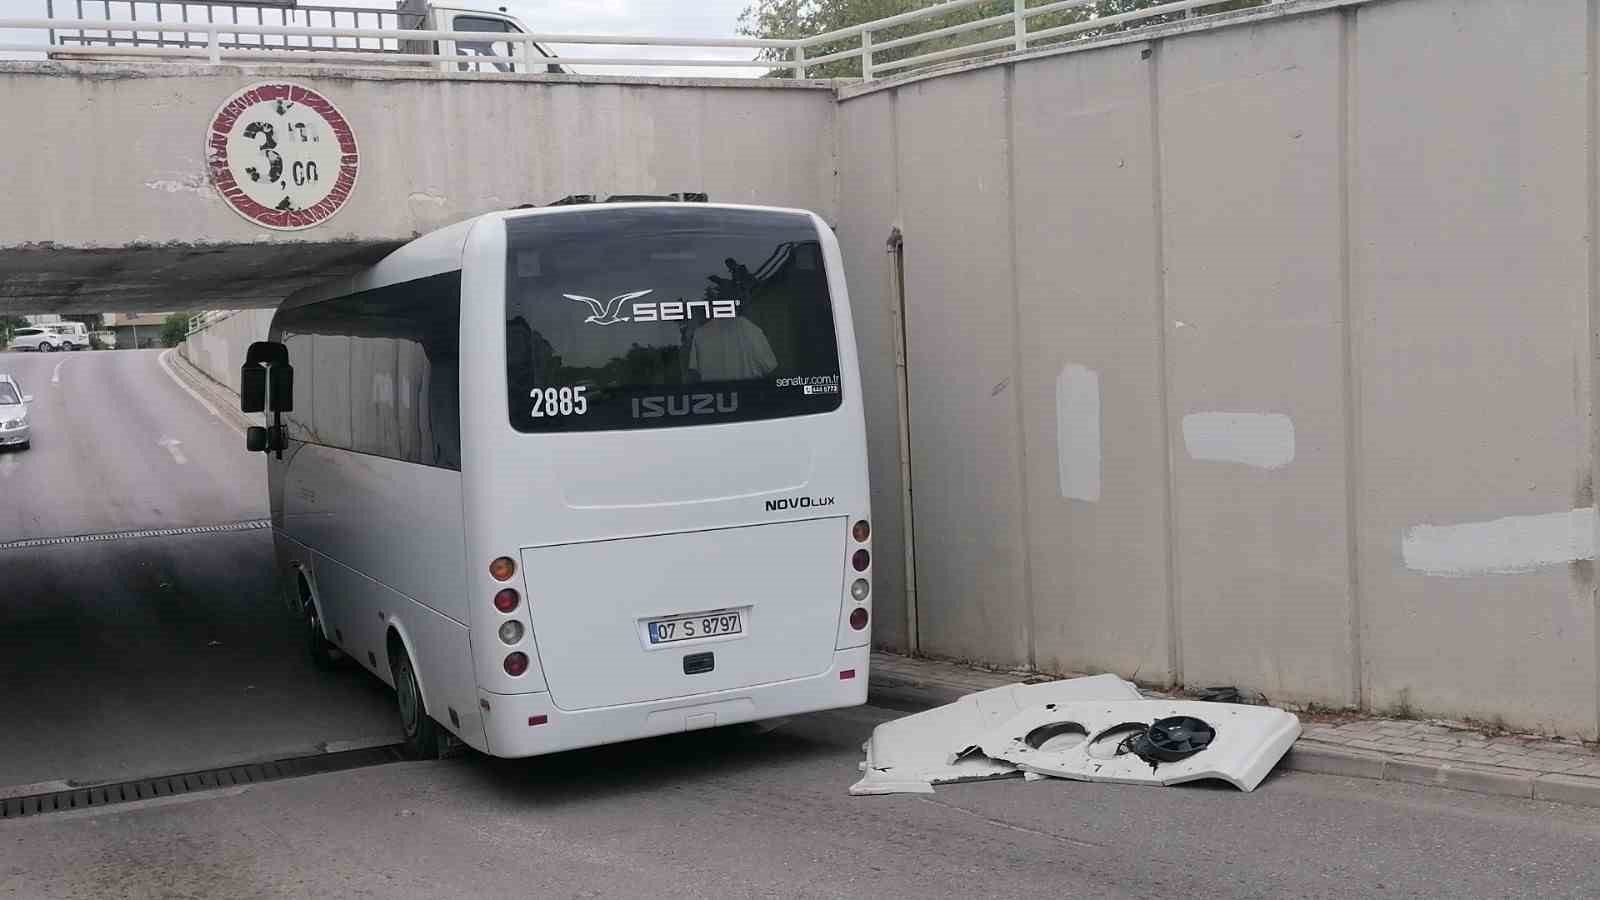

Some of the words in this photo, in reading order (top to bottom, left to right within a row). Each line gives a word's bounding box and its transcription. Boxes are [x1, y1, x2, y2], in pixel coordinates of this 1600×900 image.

[632, 300, 737, 322] sena
[776, 374, 839, 387] senatur.com.tr
[529, 386, 588, 418] 2885
[631, 391, 739, 419] ISUZU
[765, 496, 835, 511] NOVOLUX
[658, 622, 676, 640] 07
[683, 620, 696, 637] S
[702, 615, 738, 634] 8797
